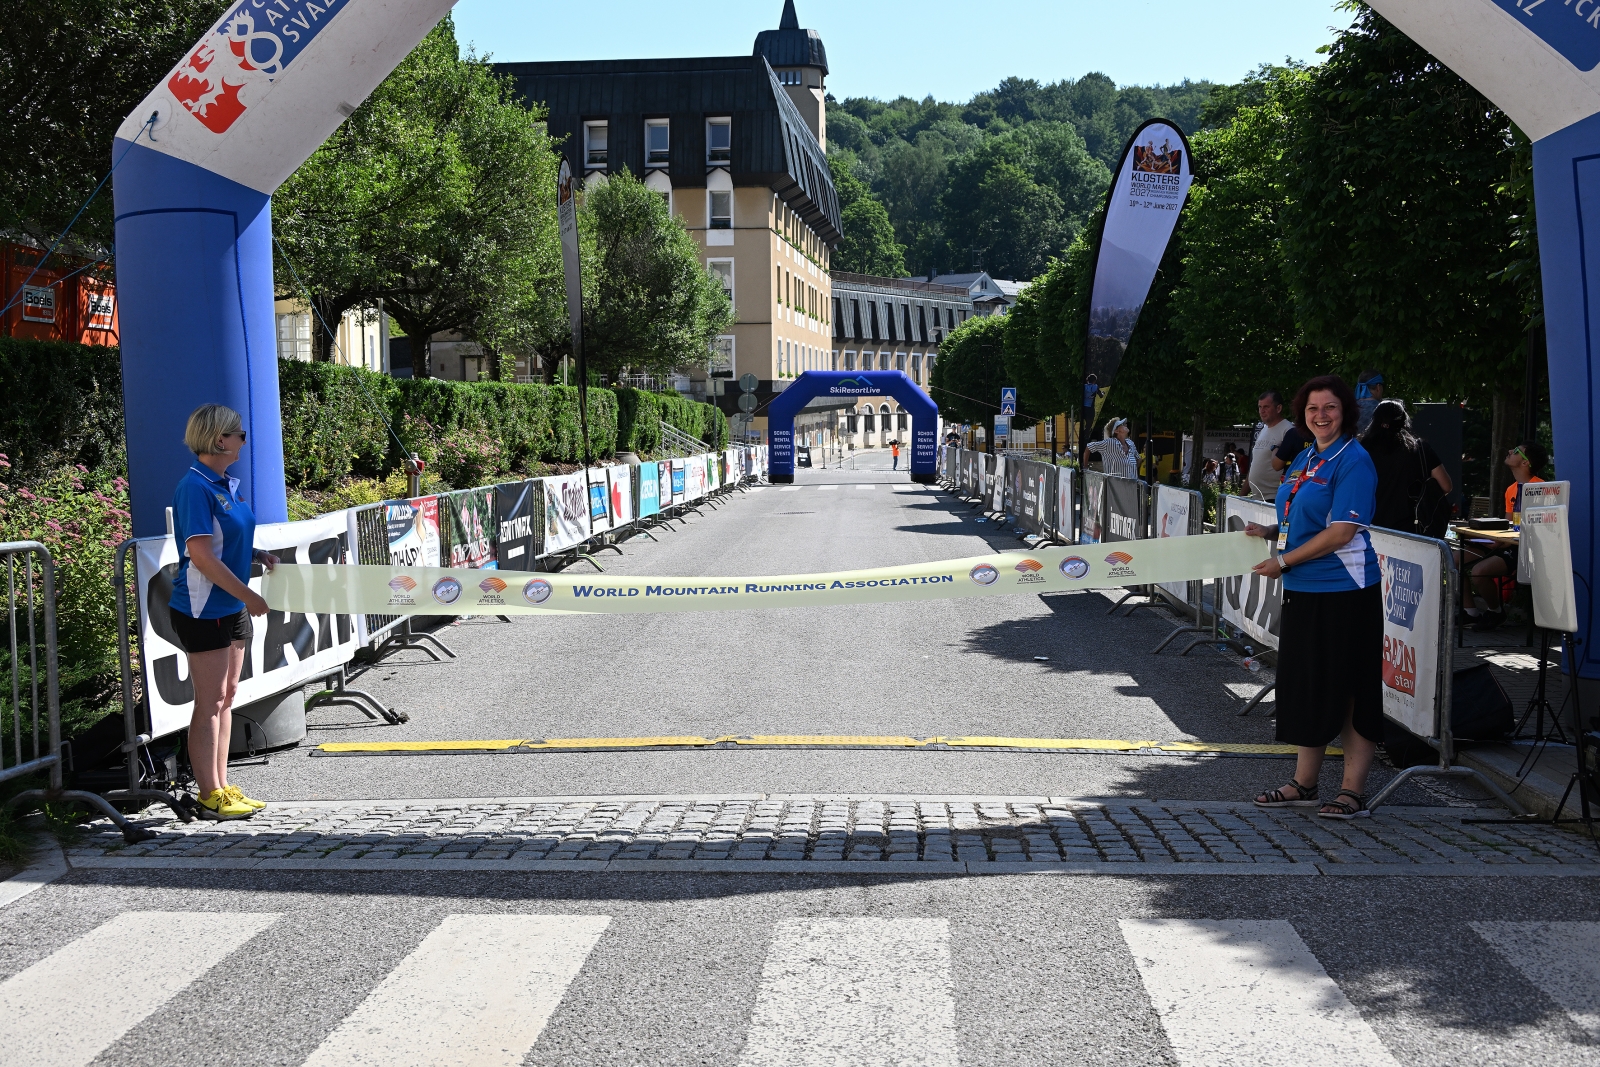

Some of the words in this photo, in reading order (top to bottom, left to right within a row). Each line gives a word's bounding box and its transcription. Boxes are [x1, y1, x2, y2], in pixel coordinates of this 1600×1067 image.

[1131, 172, 1180, 186] KLOSTERS
[1130, 188, 1150, 197] 2027
[1153, 202, 1165, 210] June
[1165, 203, 1178, 211] 2027
[25, 292, 53, 306] Boels
[90, 301, 112, 314] Boels
[829, 386, 881, 394] SkiResortLive
[1395, 563, 1411, 584] ČESKÝ
[1394, 586, 1423, 607] ATLETICKÝ
[1393, 602, 1407, 621] SVAZ
